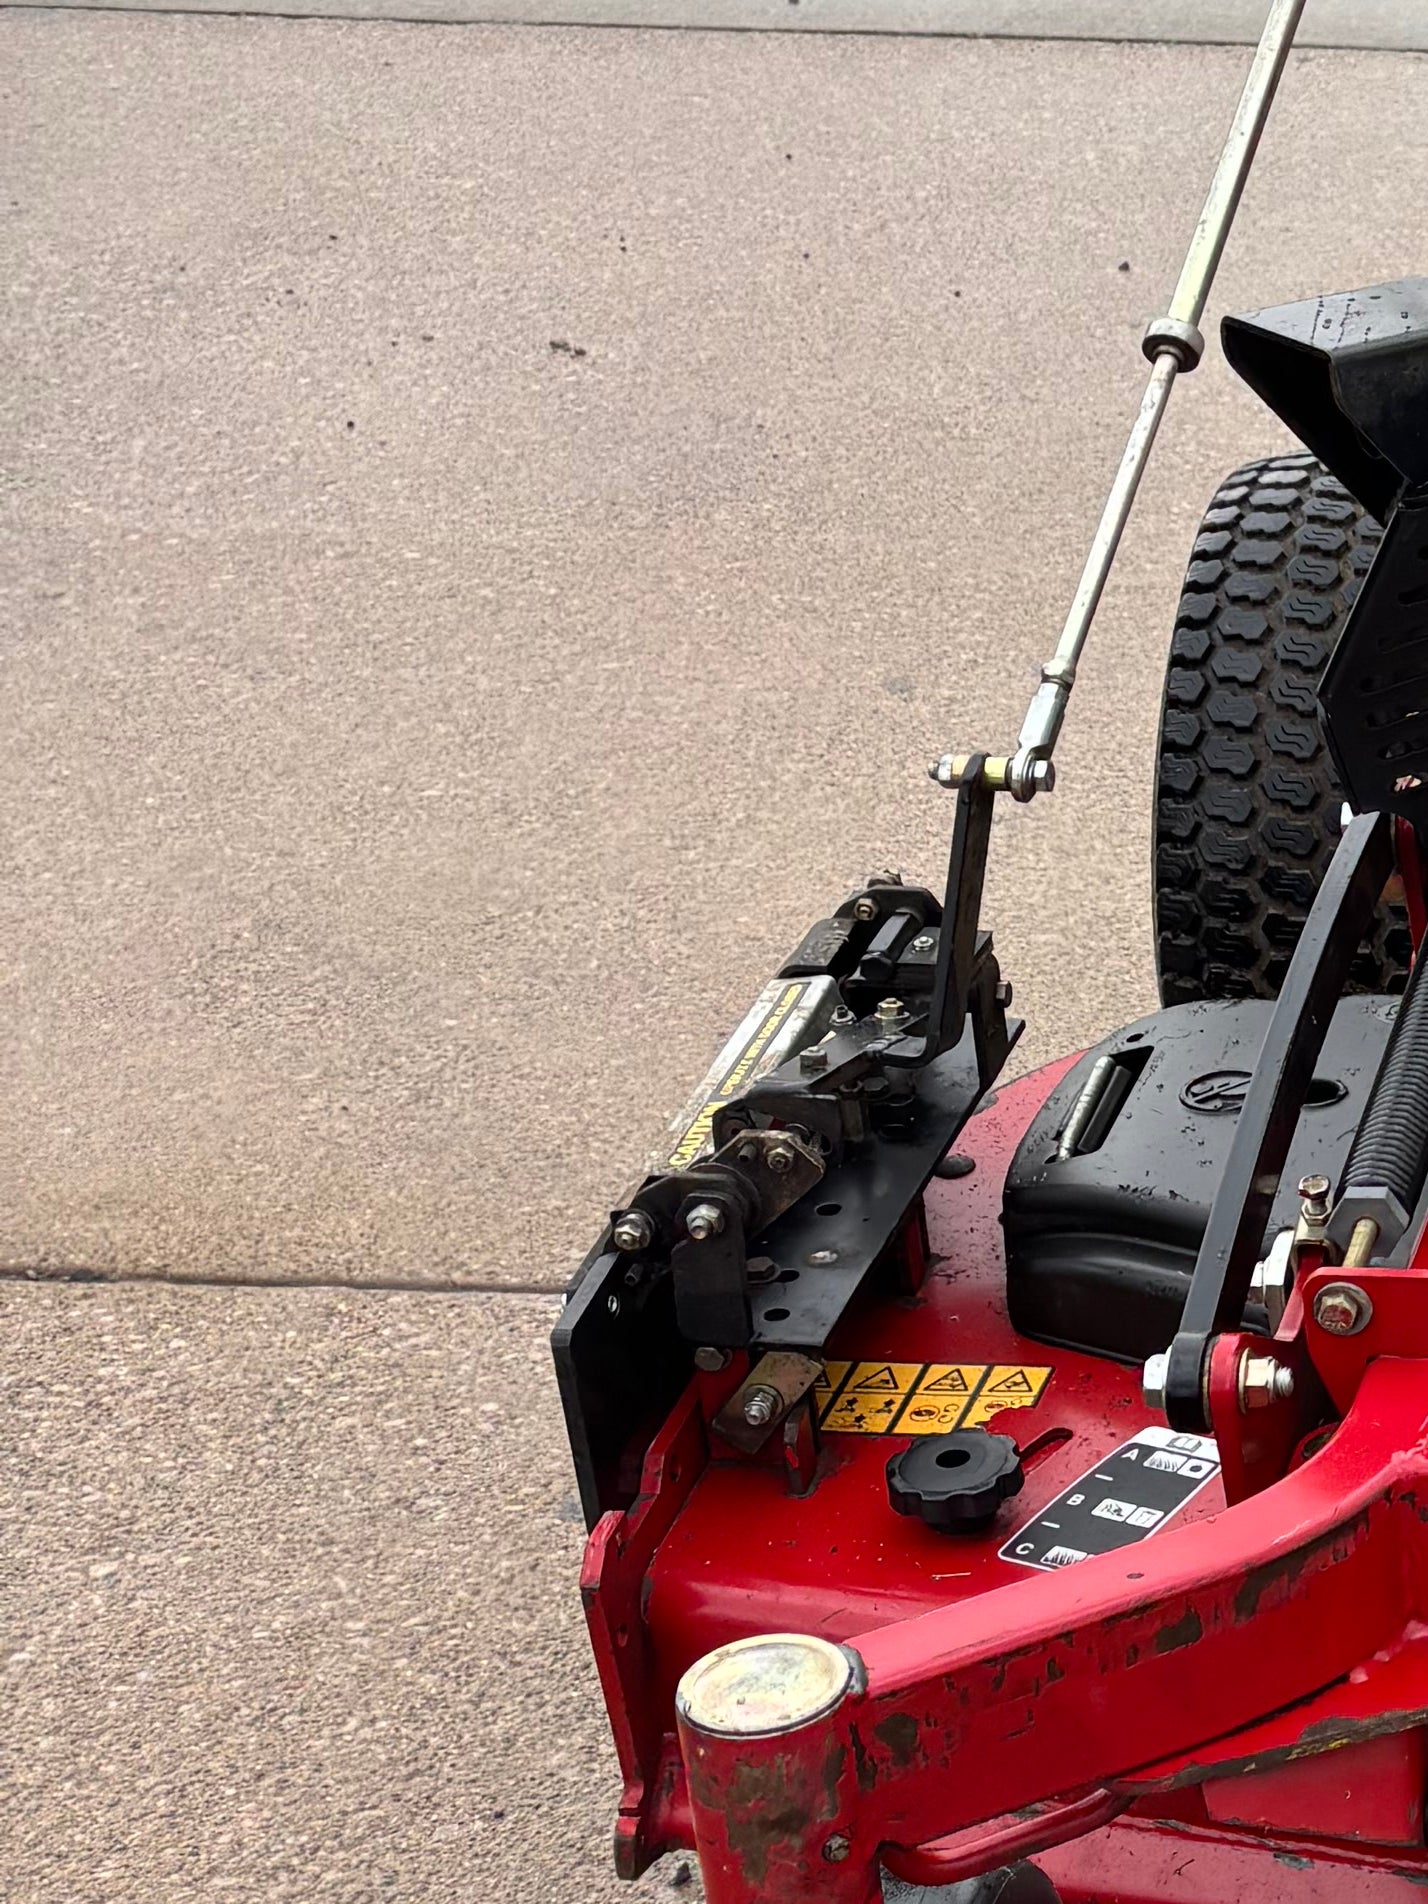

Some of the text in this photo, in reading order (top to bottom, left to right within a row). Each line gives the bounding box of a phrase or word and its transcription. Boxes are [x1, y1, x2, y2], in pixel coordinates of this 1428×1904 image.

[1121, 1448, 1139, 1462] A
[1066, 1494, 1086, 1506] B
[1015, 1542, 1035, 1555] C
